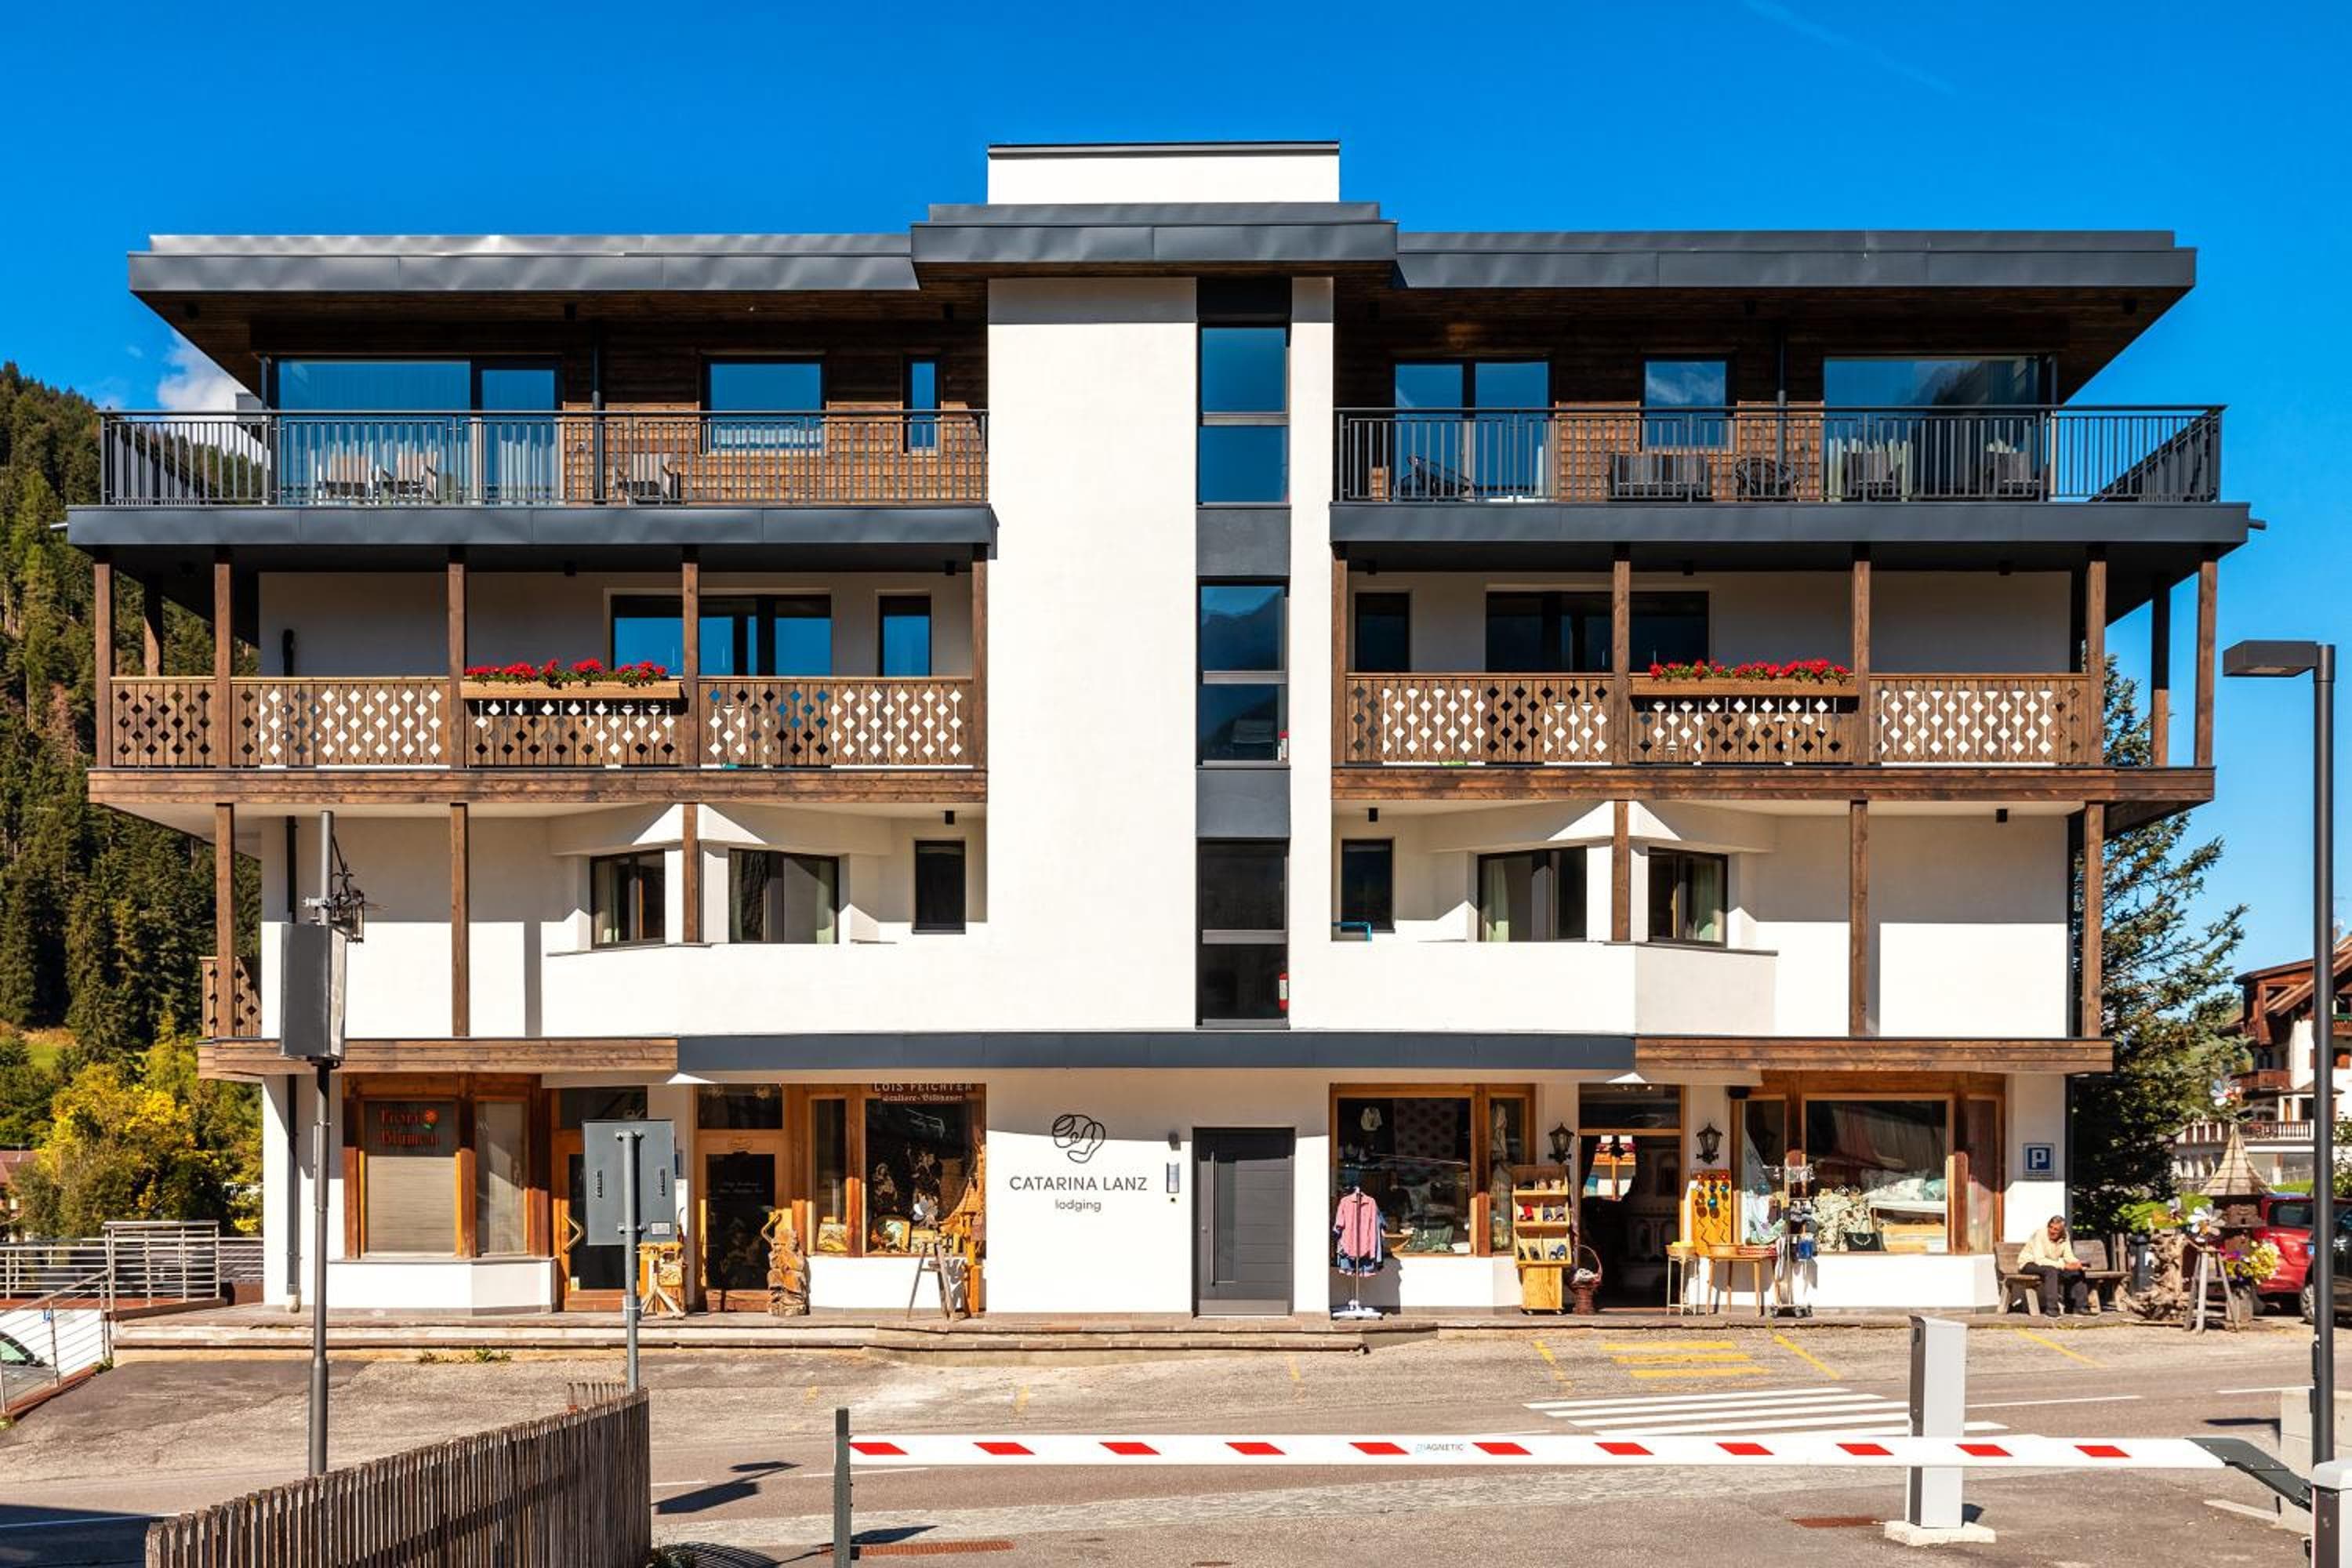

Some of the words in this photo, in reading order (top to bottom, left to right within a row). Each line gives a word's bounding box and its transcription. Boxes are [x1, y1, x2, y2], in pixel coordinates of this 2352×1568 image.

[873, 1082, 904, 1092] LOIS
[2031, 1149, 2047, 1168] P
[1009, 1176, 1098, 1191] CATARINA
[1103, 1176, 1148, 1191] LANZ
[1054, 1199, 1102, 1212] lodging
